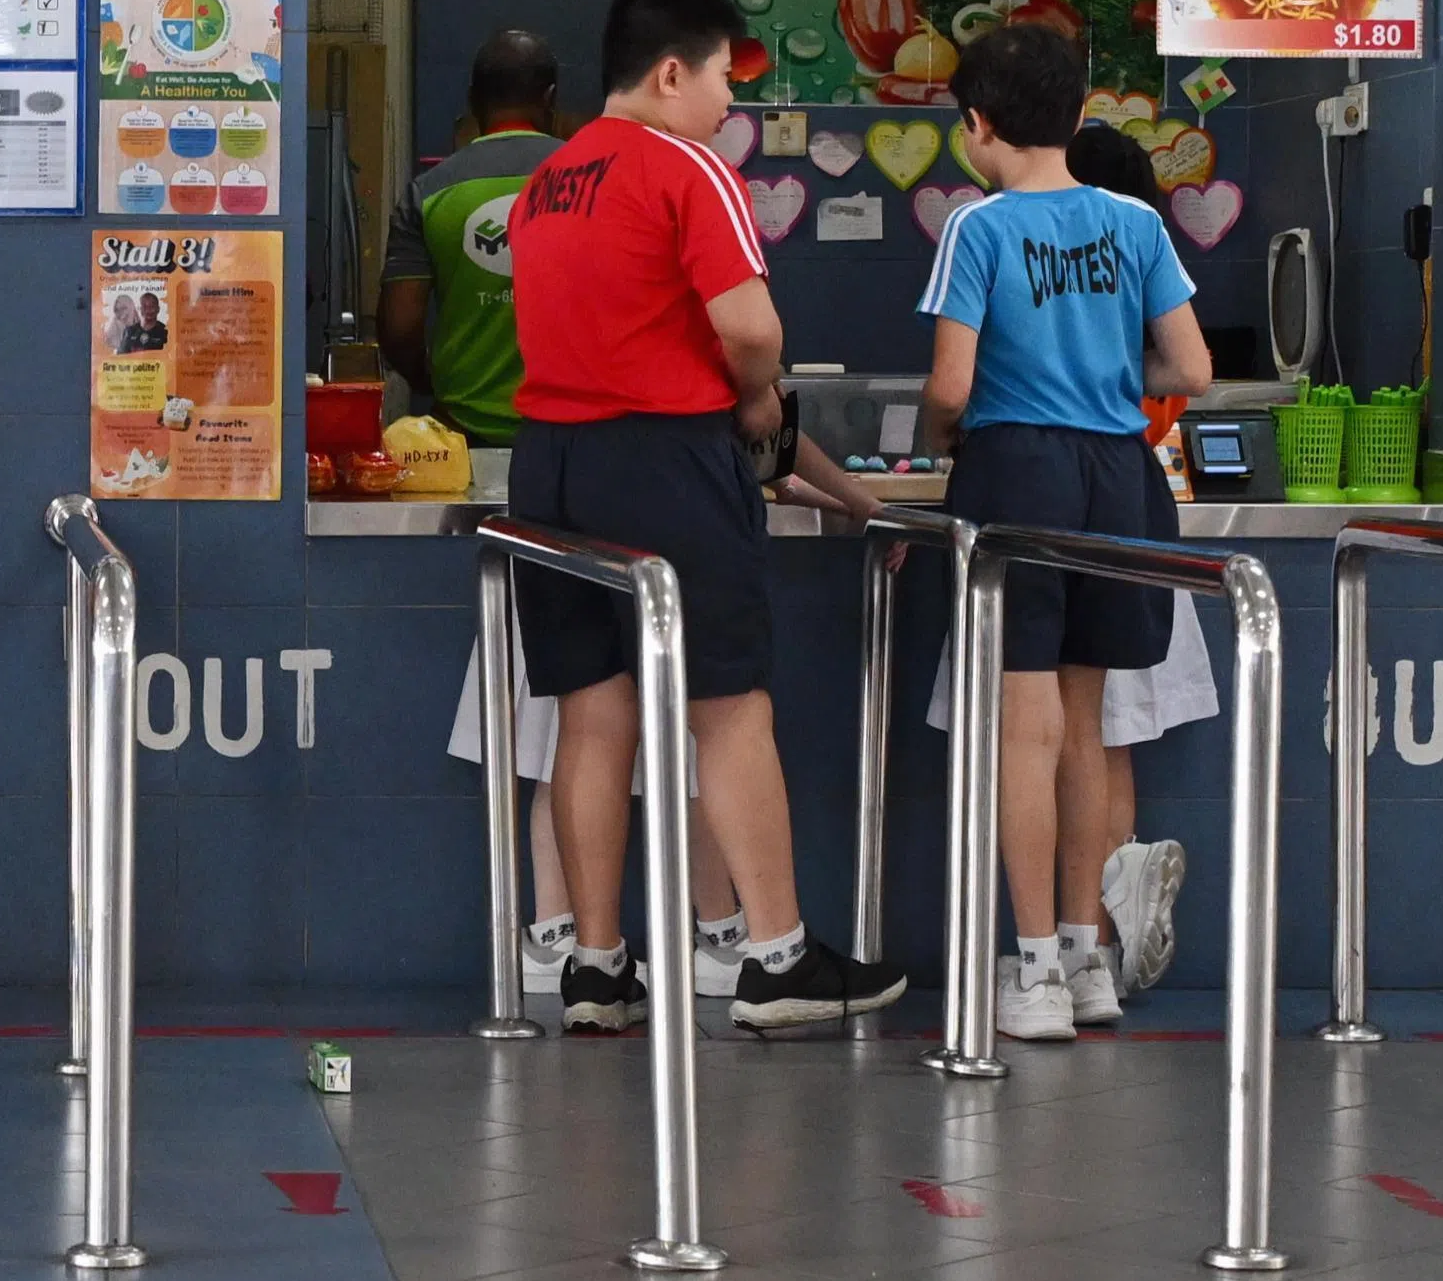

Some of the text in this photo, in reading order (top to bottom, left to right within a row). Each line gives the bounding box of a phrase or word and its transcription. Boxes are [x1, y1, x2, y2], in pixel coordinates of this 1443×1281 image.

[1333, 23, 1402, 48] $1.80
[155, 76, 168, 84] Eat
[198, 76, 221, 84] Active
[222, 76, 232, 84] for
[140, 84, 247, 98] A Healthier You
[98, 236, 213, 271] Stall 3!
[132, 362, 161, 373] polite?
[136, 649, 333, 758] OUT
